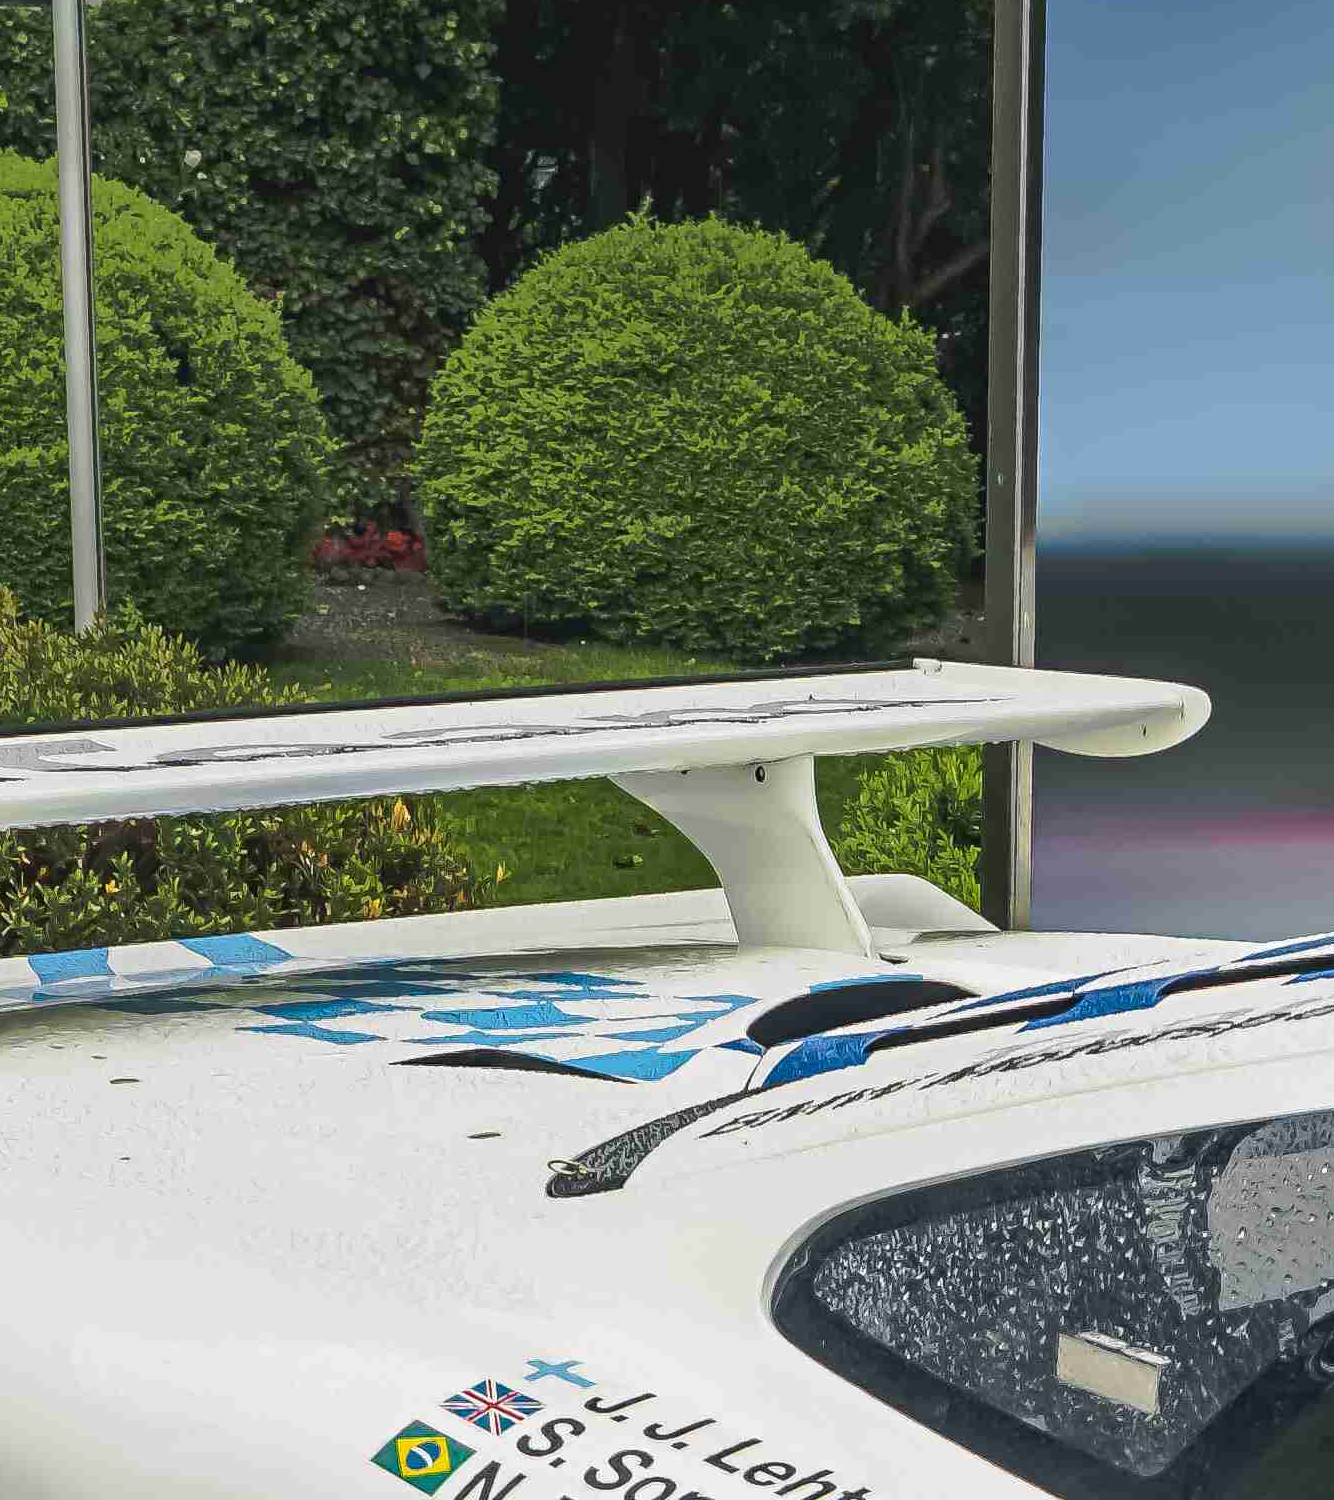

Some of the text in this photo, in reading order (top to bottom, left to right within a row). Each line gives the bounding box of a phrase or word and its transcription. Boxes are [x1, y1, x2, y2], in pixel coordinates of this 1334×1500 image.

[516, 1417, 587, 1468] S.
[584, 1392, 657, 1423] J.
[643, 1416, 717, 1451] J.
